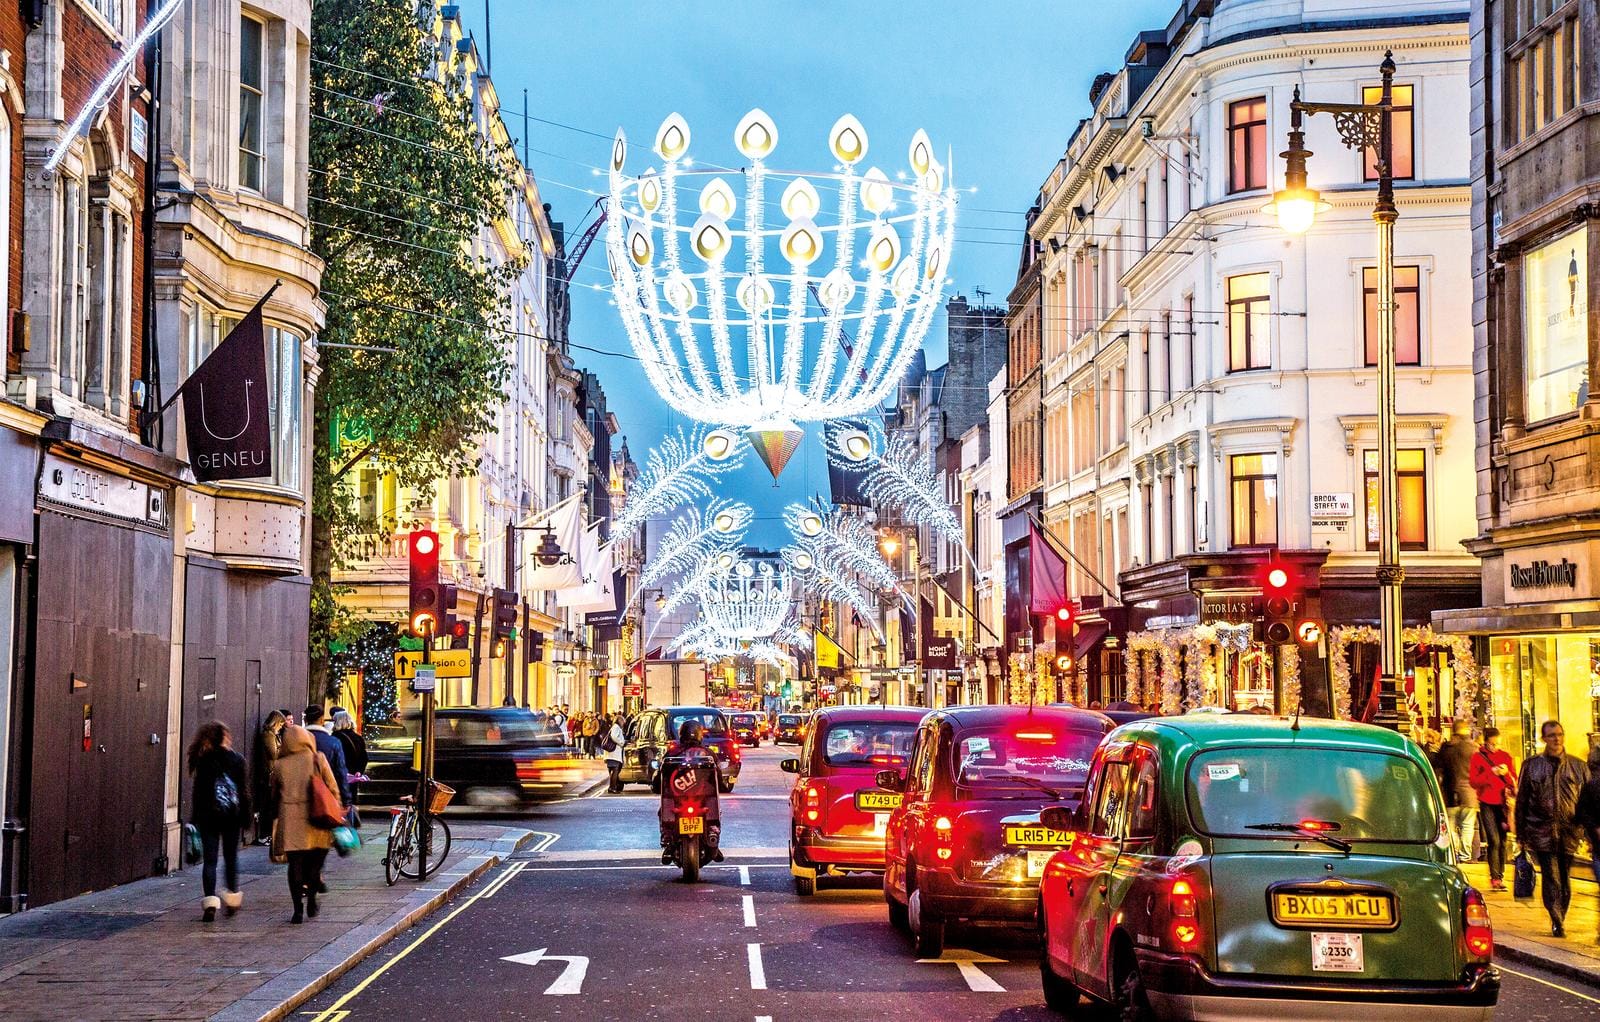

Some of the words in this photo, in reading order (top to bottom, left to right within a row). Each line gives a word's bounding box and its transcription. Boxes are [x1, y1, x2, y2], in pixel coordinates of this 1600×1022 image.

[197, 450, 264, 469] GENEU
[1510, 561, 1536, 589] Russell
[1541, 557, 1578, 592] Bromley
[411, 659, 455, 668] Dirsion
[864, 796, 890, 806] Y749
[1015, 829, 1044, 843] LR15
[1286, 897, 1338, 916] BX05
[1343, 898, 1380, 917] WCU
